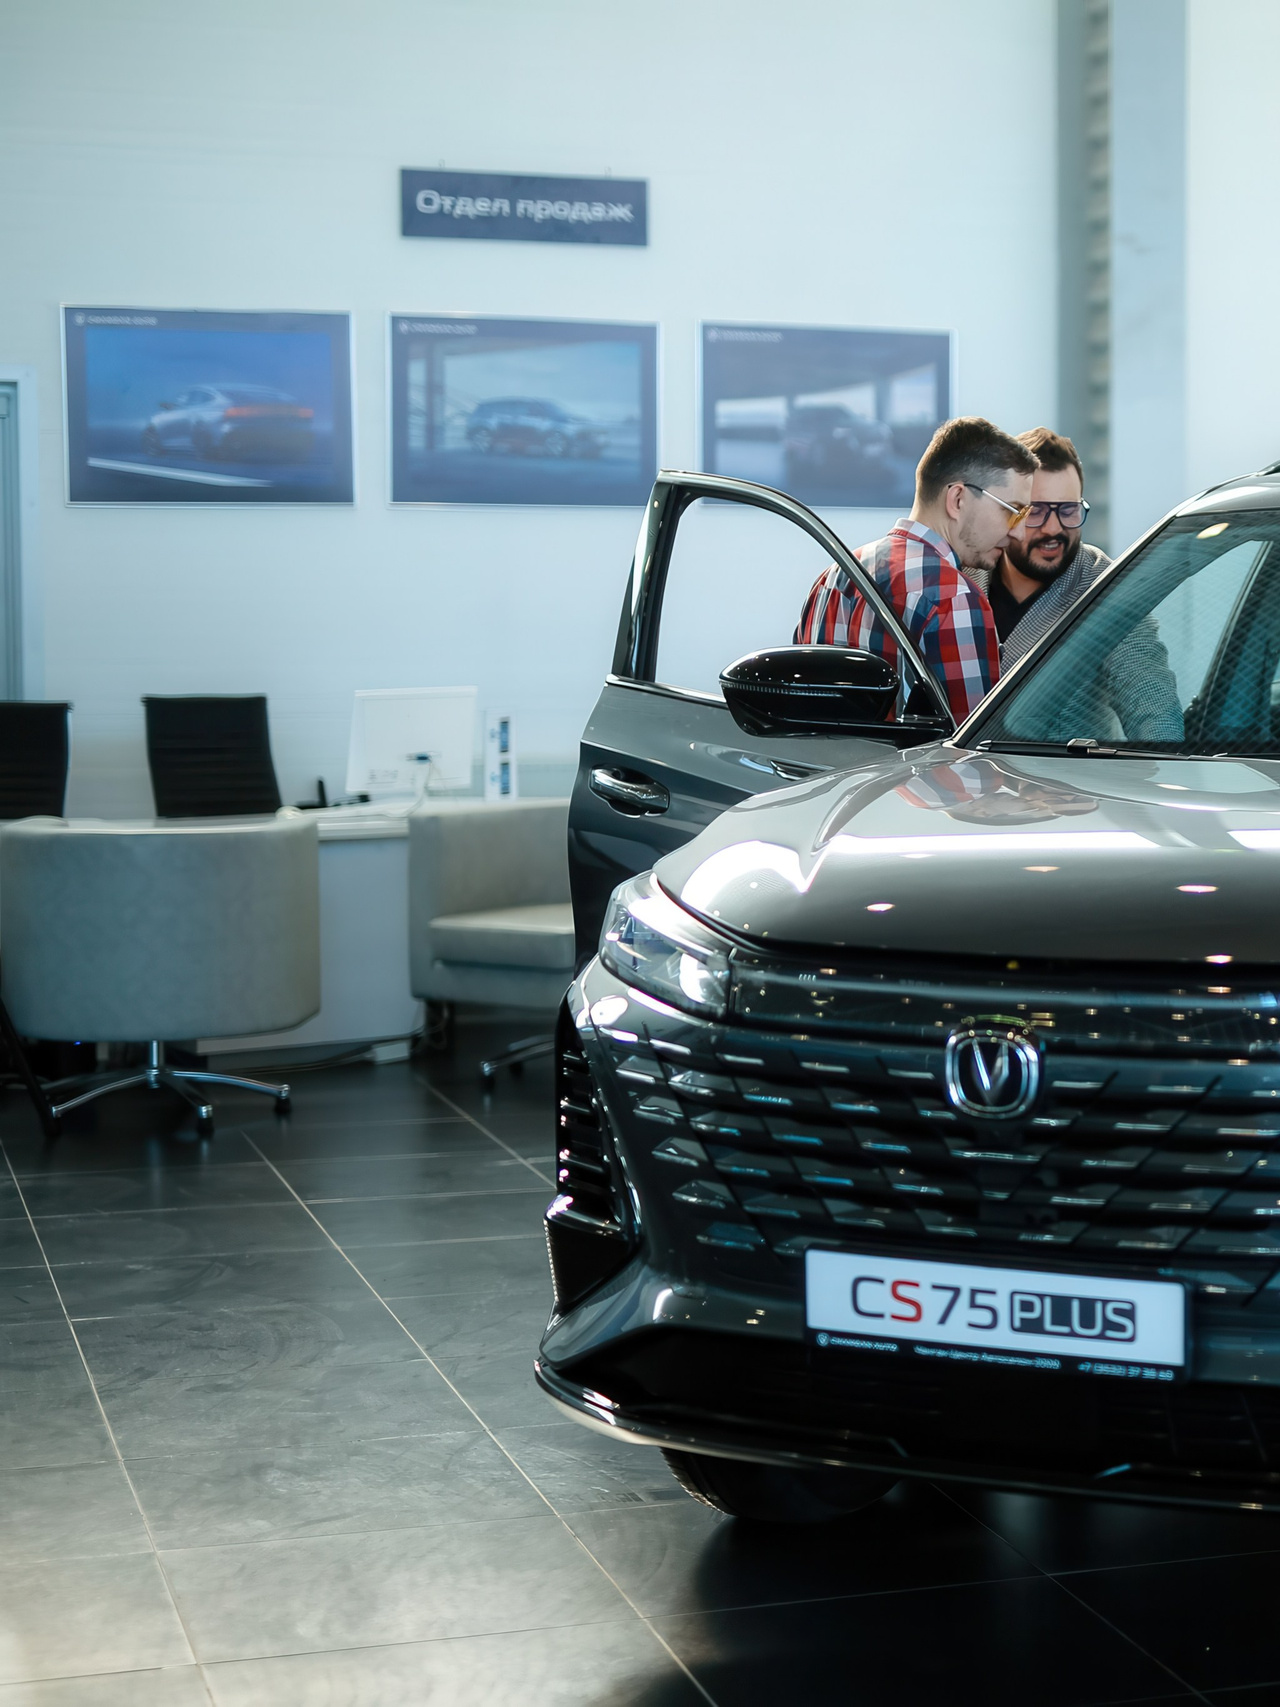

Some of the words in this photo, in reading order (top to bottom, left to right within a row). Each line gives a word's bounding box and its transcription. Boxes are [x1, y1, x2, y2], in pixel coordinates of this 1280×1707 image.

[415, 189, 511, 219] Отдел
[516, 197, 635, 224] продаж
[1013, 1292, 1136, 1340] PLUS
